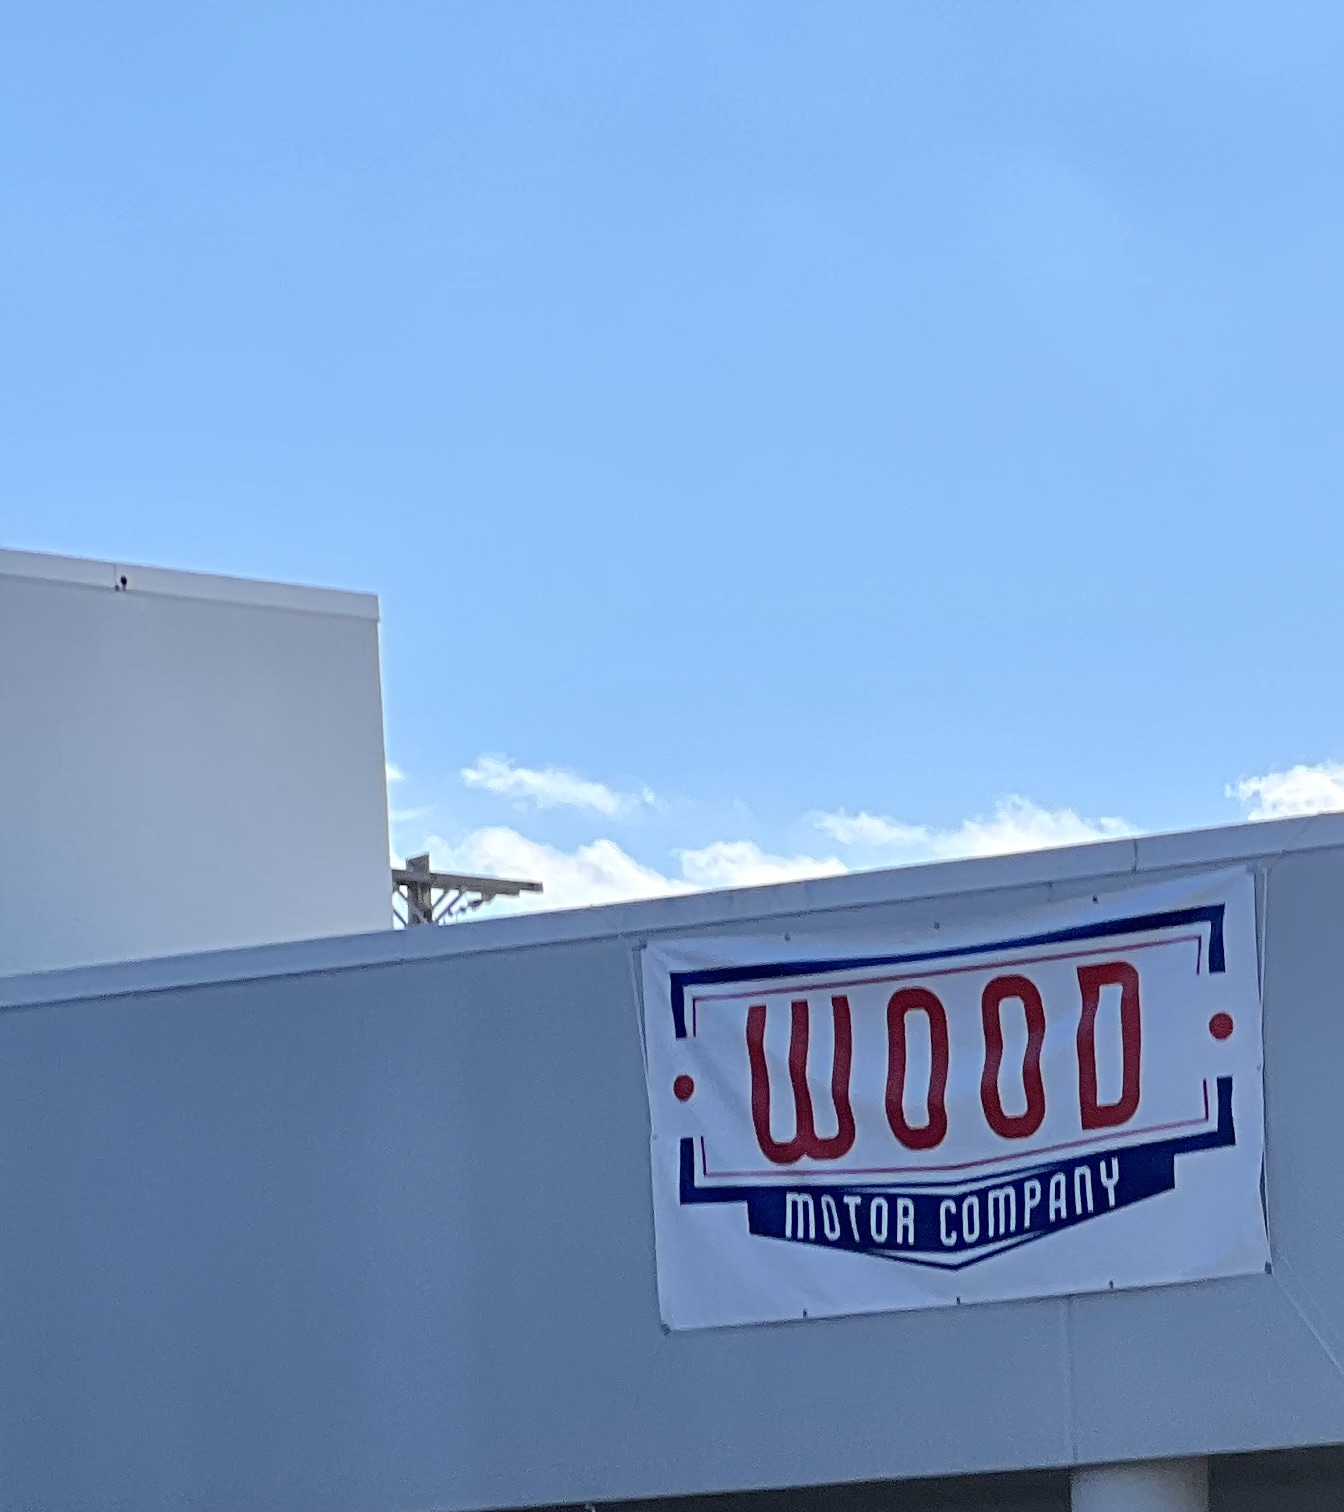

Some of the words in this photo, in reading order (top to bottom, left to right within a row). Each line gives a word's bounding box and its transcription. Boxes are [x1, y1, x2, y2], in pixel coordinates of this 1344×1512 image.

[746, 960, 1141, 1165] WOOD
[785, 1191, 915, 1246] MOTOR
[939, 1156, 1121, 1247] COMPANY
